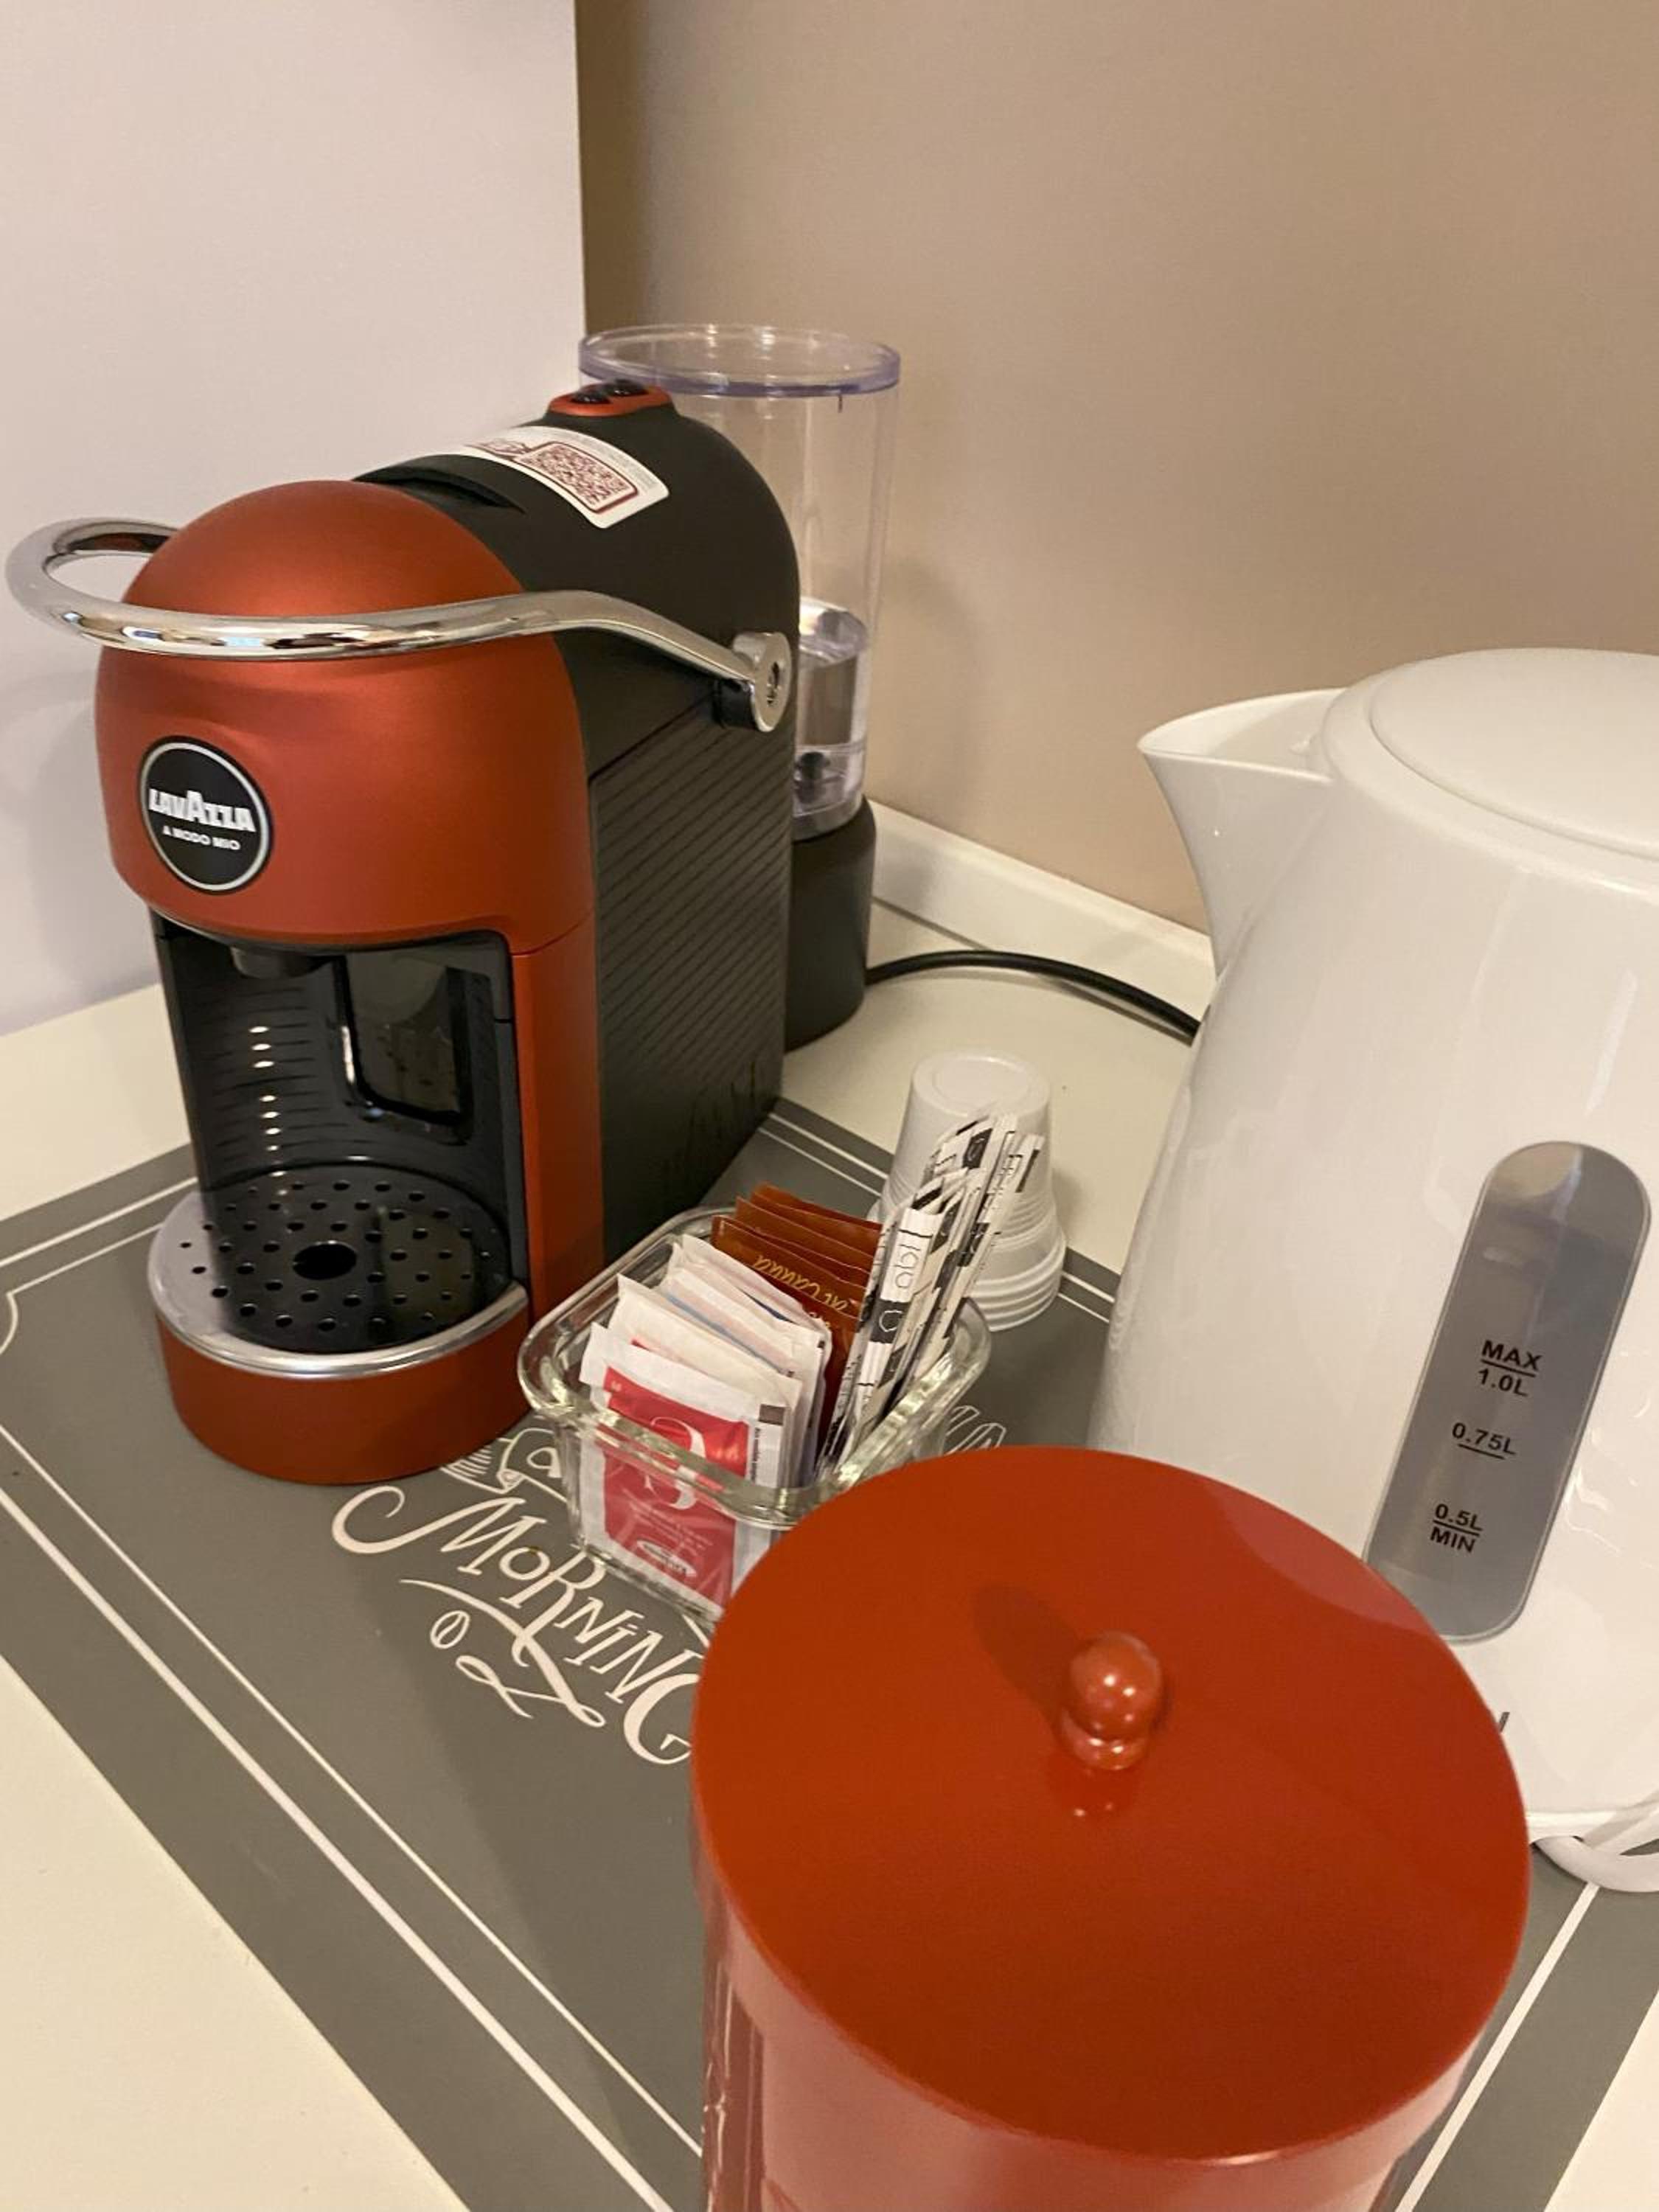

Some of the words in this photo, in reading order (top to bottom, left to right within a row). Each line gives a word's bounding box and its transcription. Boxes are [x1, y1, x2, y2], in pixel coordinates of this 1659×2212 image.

[148, 787, 256, 832] LAVAZZA
[162, 825, 171, 835] A
[172, 828, 212, 846] MODO
[1481, 1340, 1542, 1371] MAX
[1478, 1368, 1528, 1397] 1.0L
[1452, 1422, 1516, 1455] 0.75L
[1435, 1503, 1483, 1531] 0.5L
[1430, 1526, 1476, 1553] MIN
